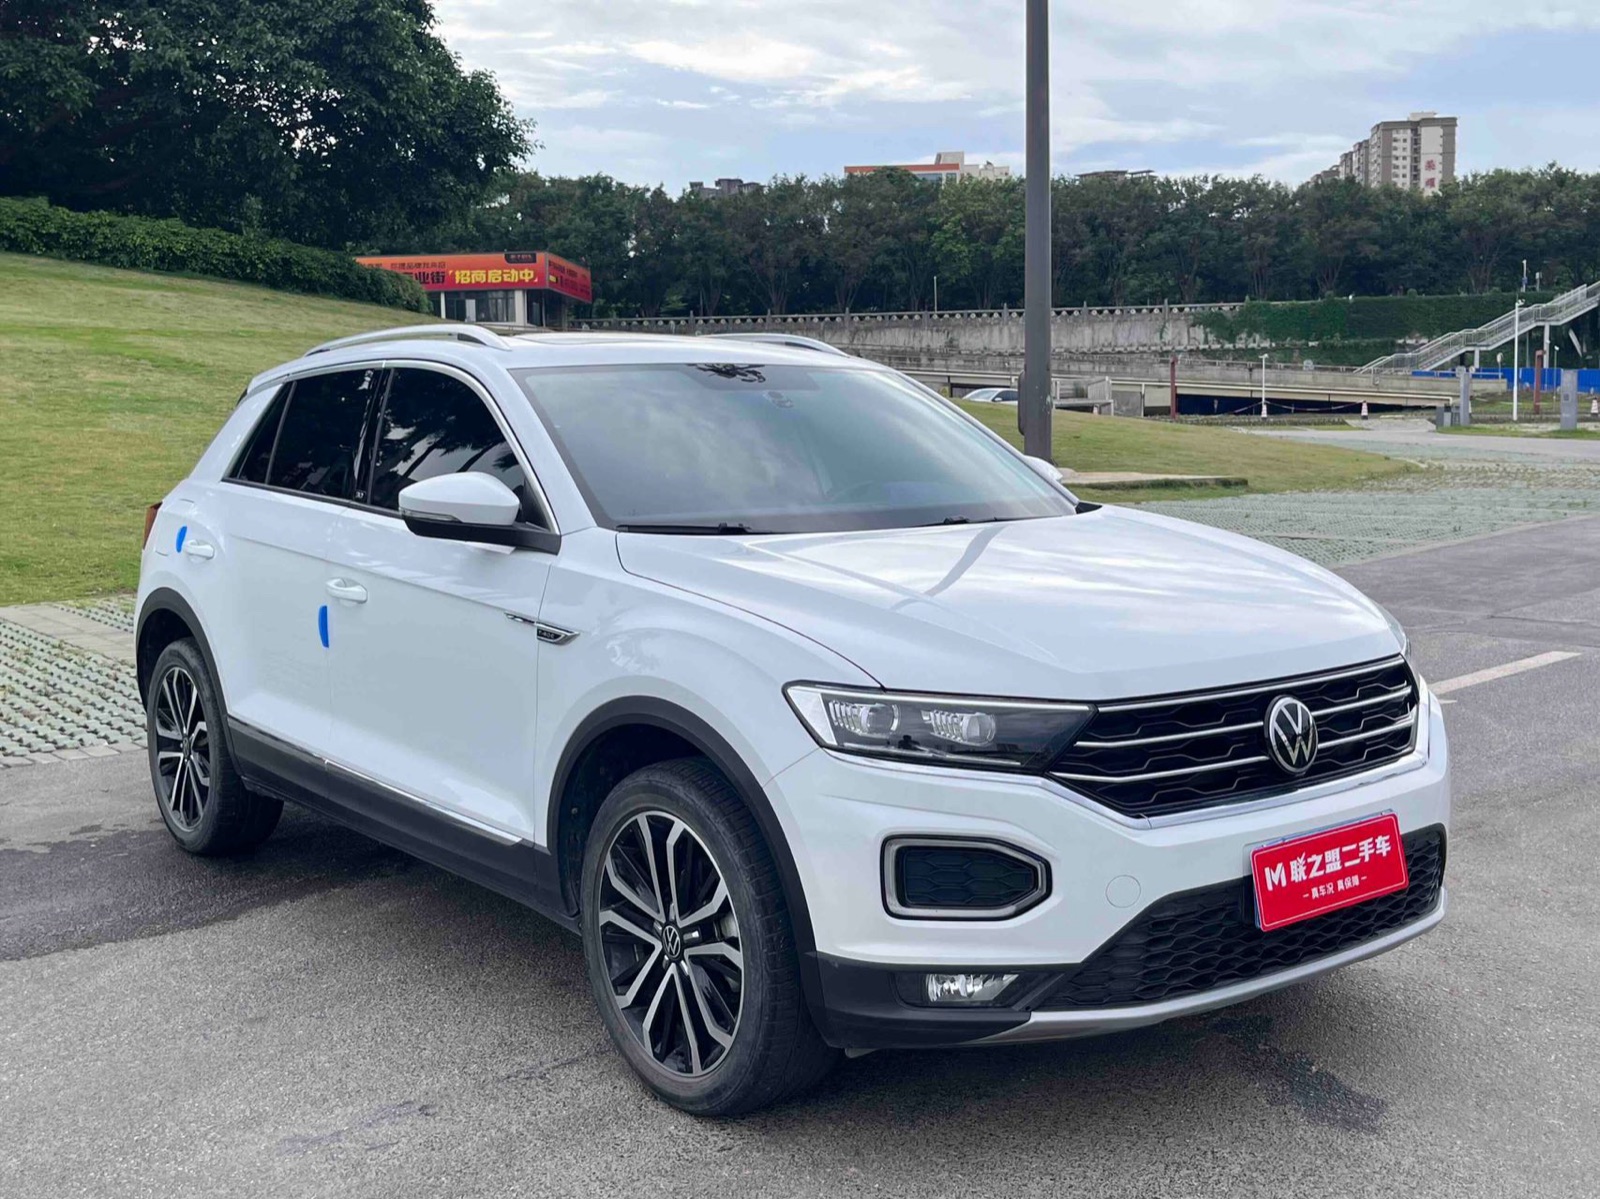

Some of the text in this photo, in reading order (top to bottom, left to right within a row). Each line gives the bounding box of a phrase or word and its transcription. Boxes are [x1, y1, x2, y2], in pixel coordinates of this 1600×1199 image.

[1290, 835, 1391, 883] 联之盟二手车
